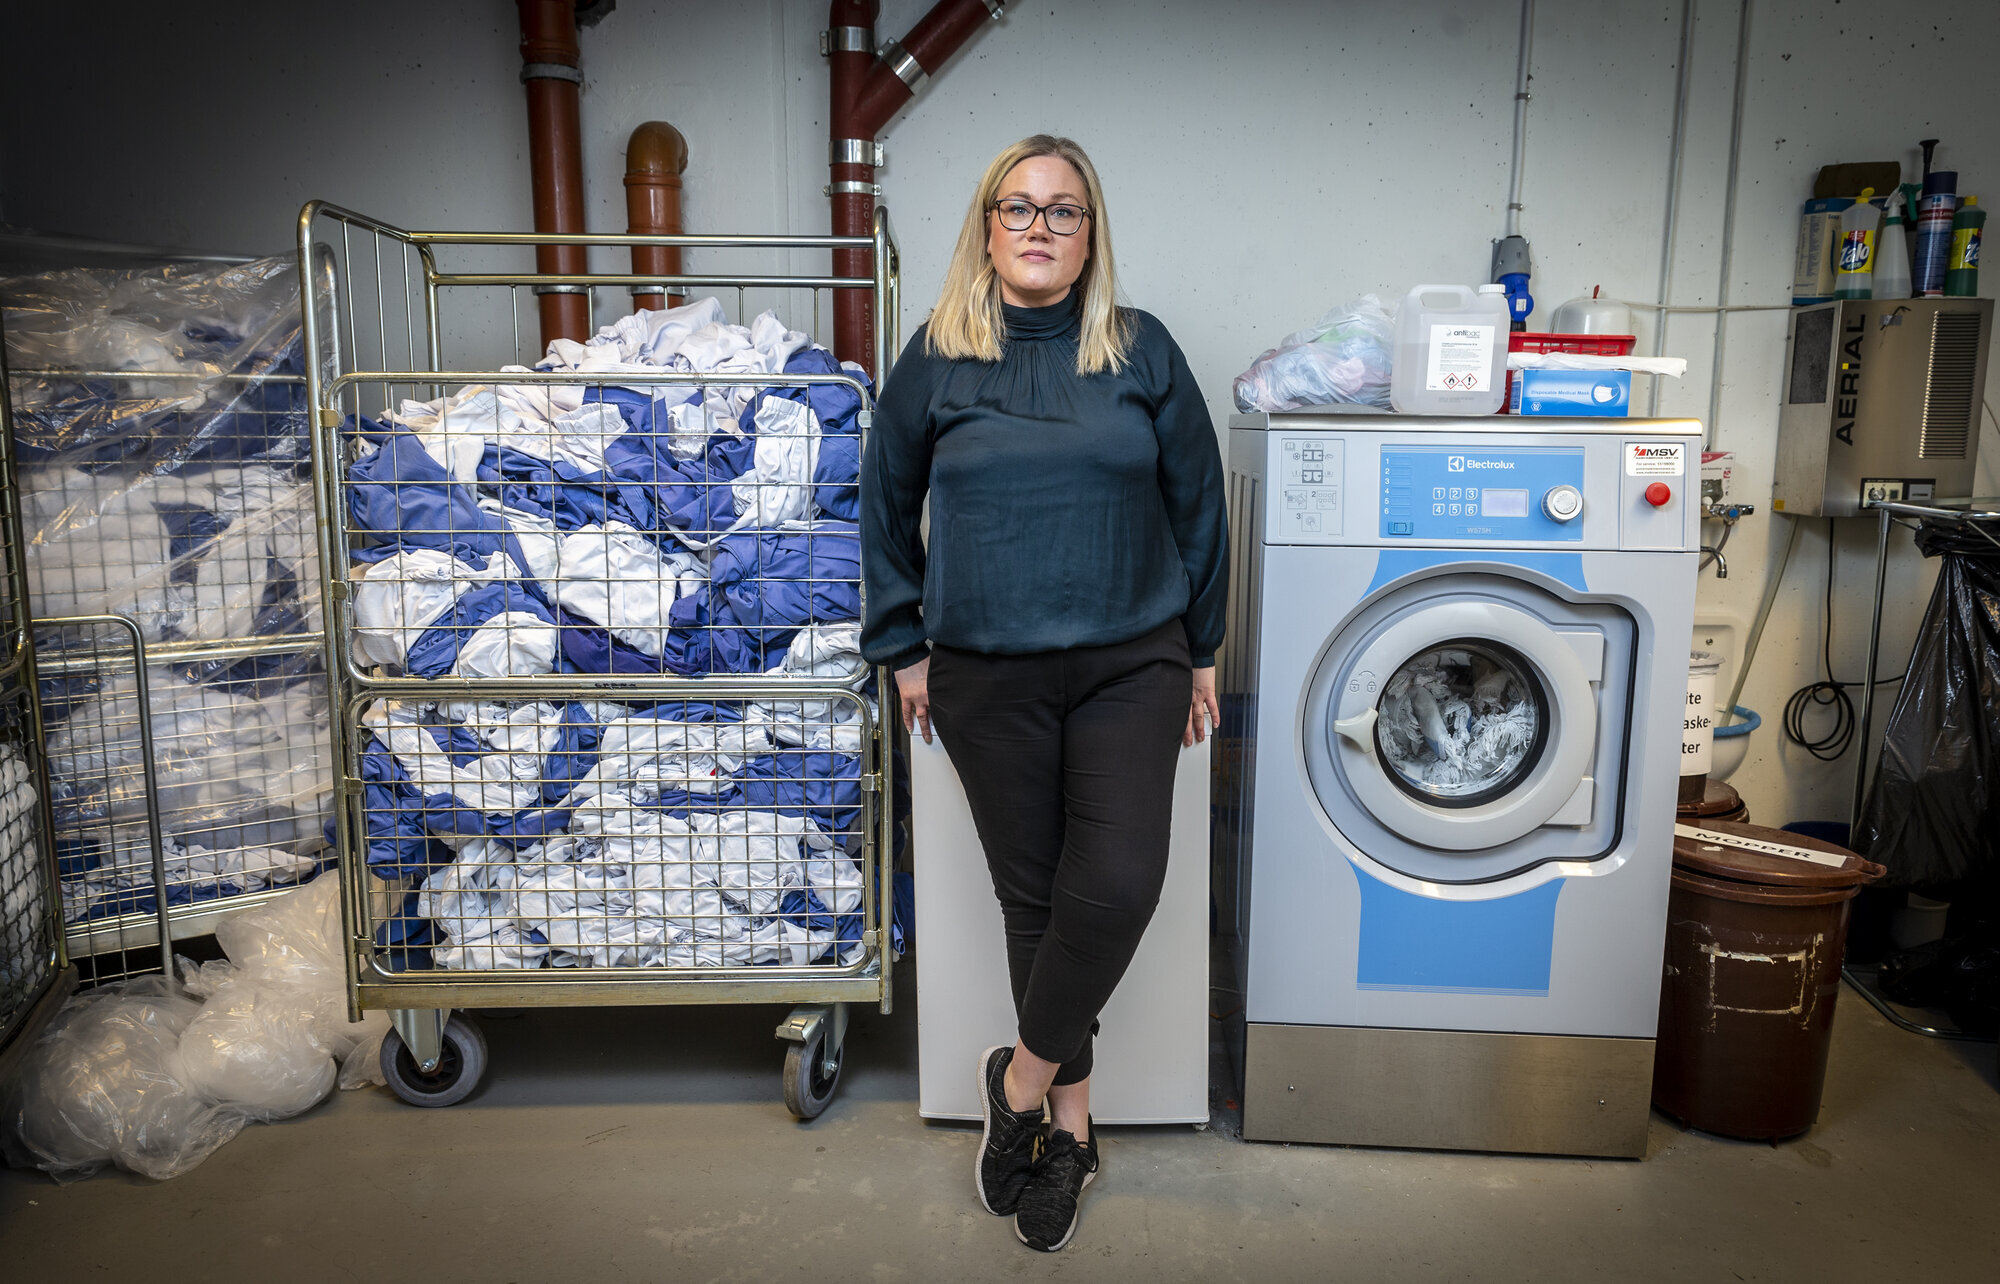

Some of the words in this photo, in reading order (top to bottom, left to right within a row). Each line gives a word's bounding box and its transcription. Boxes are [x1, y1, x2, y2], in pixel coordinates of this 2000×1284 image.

[1839, 242, 1870, 265] Zalo
[1836, 314, 1866, 446] AERIAL
[1646, 448, 1679, 456] MSV
[1467, 459, 1515, 469] Electrolux
[1436, 489, 1441, 498] 1
[1452, 489, 1458, 498] 2
[1468, 489, 1475, 498] 3
[1384, 507, 1389, 515] 6
[1435, 505, 1441, 514] 4
[1451, 505, 1458, 514] 5
[1468, 505, 1474, 514] 6
[1296, 512, 1302, 520] 3
[1695, 832, 1811, 859] MOPPER
